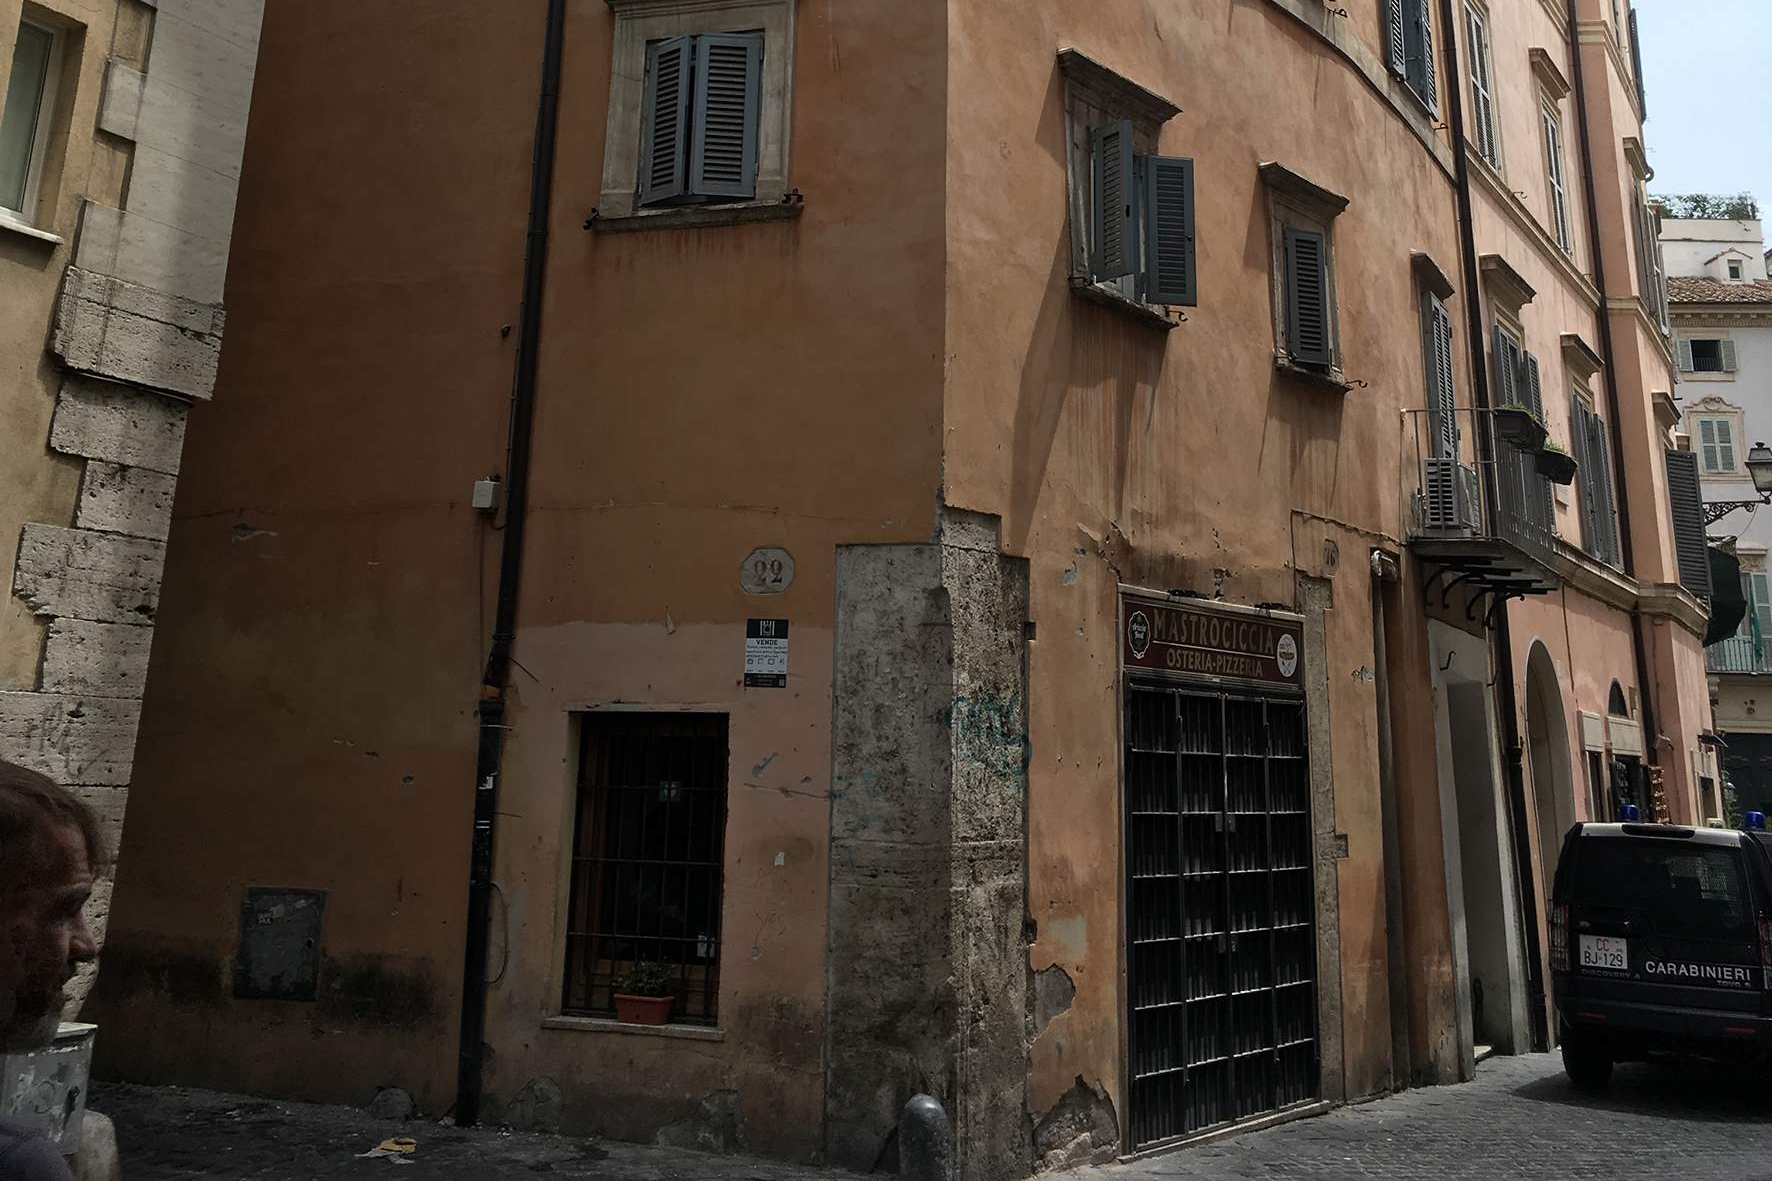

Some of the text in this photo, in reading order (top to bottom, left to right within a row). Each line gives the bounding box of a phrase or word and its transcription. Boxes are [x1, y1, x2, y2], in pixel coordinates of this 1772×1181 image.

[754, 559, 783, 586] 22
[1153, 609, 1275, 654] MASTROCICCIA
[1166, 649, 1263, 677] OSTERIA-PIZZERIA
[1596, 938, 1610, 951] CC
[1582, 968, 1630, 979] DISCOVERY
[1646, 961, 1751, 981] CARABINIERI
